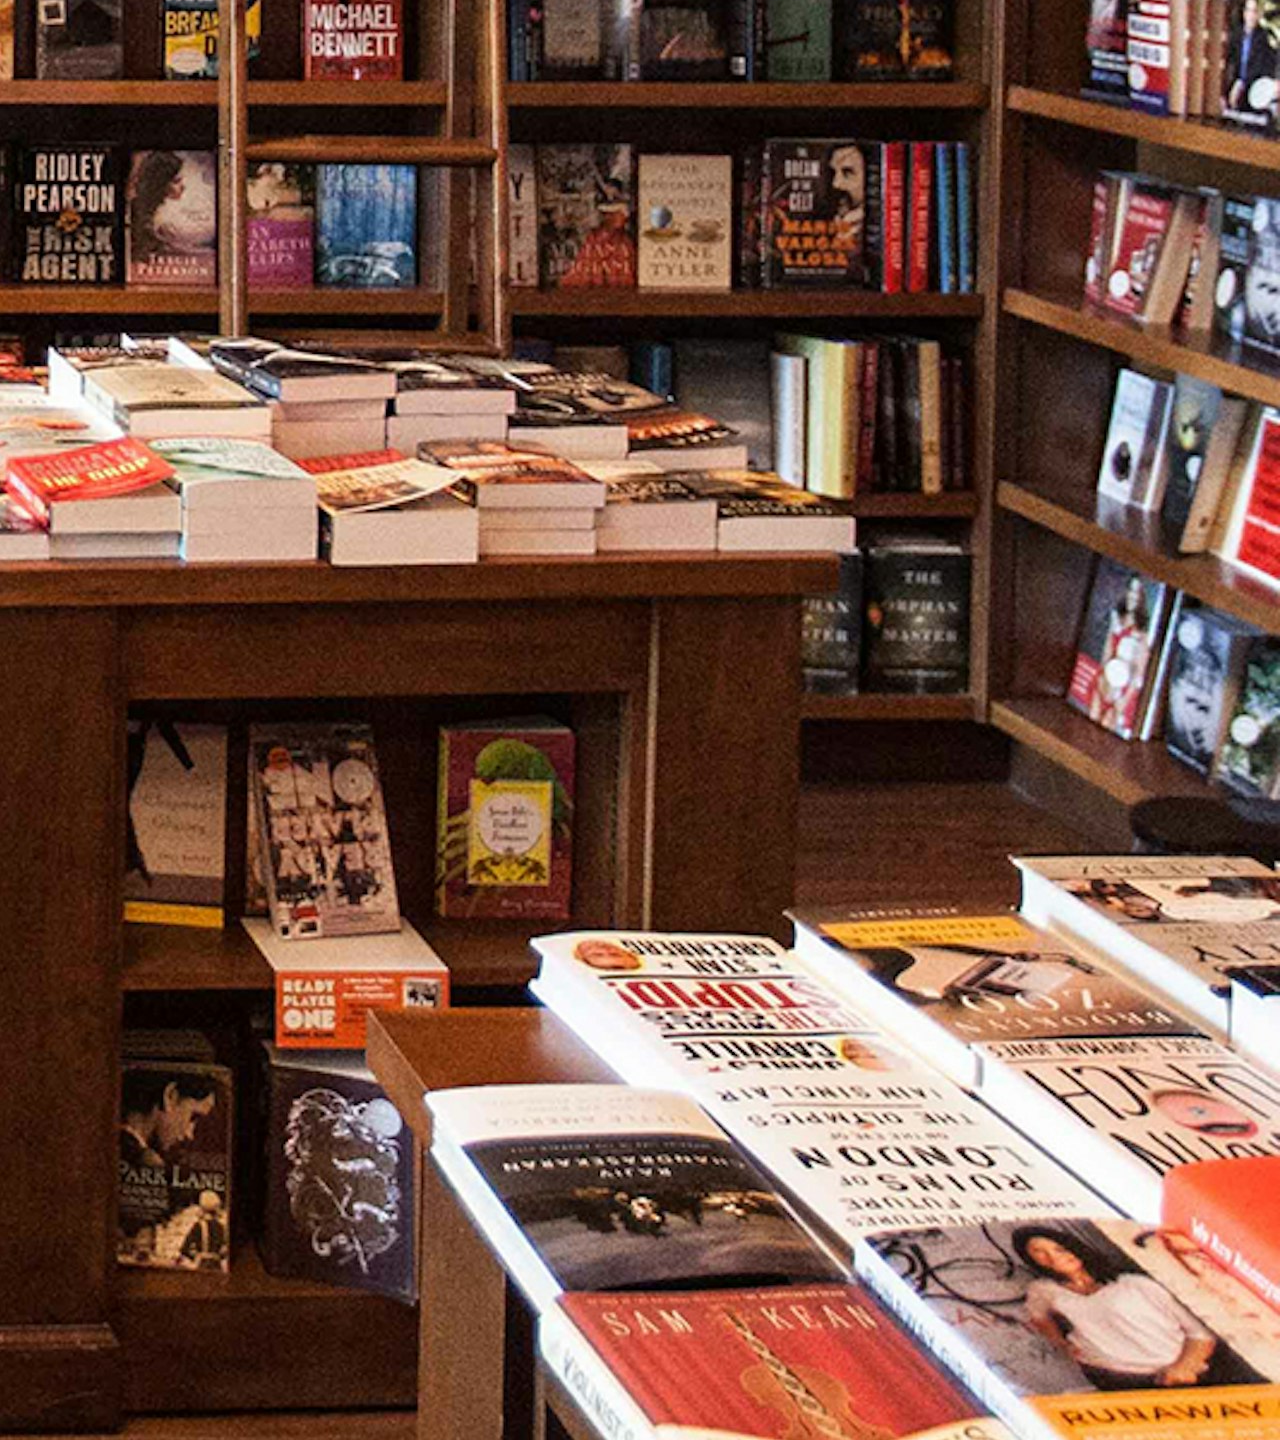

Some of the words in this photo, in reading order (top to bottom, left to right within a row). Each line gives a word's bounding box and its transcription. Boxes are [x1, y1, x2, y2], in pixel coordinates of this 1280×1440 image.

[310, 4, 399, 29] MICHAEL
[1128, 18, 1162, 37] MARCO
[310, 33, 399, 58] BENNETT
[35, 154, 105, 182] RIDLEY
[23, 182, 116, 213] PEARSON
[42, 226, 114, 252] RISK
[653, 247, 713, 258] ANNE
[782, 252, 849, 267] LLOSA
[23, 252, 114, 281] AGENT
[649, 263, 718, 278] TYLER
[903, 571, 942, 585] THE
[884, 600, 959, 614] ORPHAN
[883, 629, 958, 643] MASTER
[619, 938, 773, 961] GREENBERG
[686, 958, 750, 974] STAN
[282, 980, 335, 994] READY
[607, 979, 841, 1011] STUPID!
[283, 994, 336, 1008] PLAYER
[960, 988, 1112, 1013] ZOO
[283, 1009, 336, 1031] ONE
[953, 1012, 1173, 1038] BROOKLYN
[671, 1042, 839, 1062] CARVILLE
[720, 1087, 877, 1103] SINCLAIR
[170, 1168, 226, 1193] LANE
[599, 1167, 672, 1178] RAJIV
[886, 1173, 1034, 1193] RUINS
[844, 1198, 962, 1212] FUTURE
[600, 1308, 694, 1337] SAM
[759, 1304, 877, 1333] KEAN
[1060, 1400, 1265, 1426] RUNAWAY
